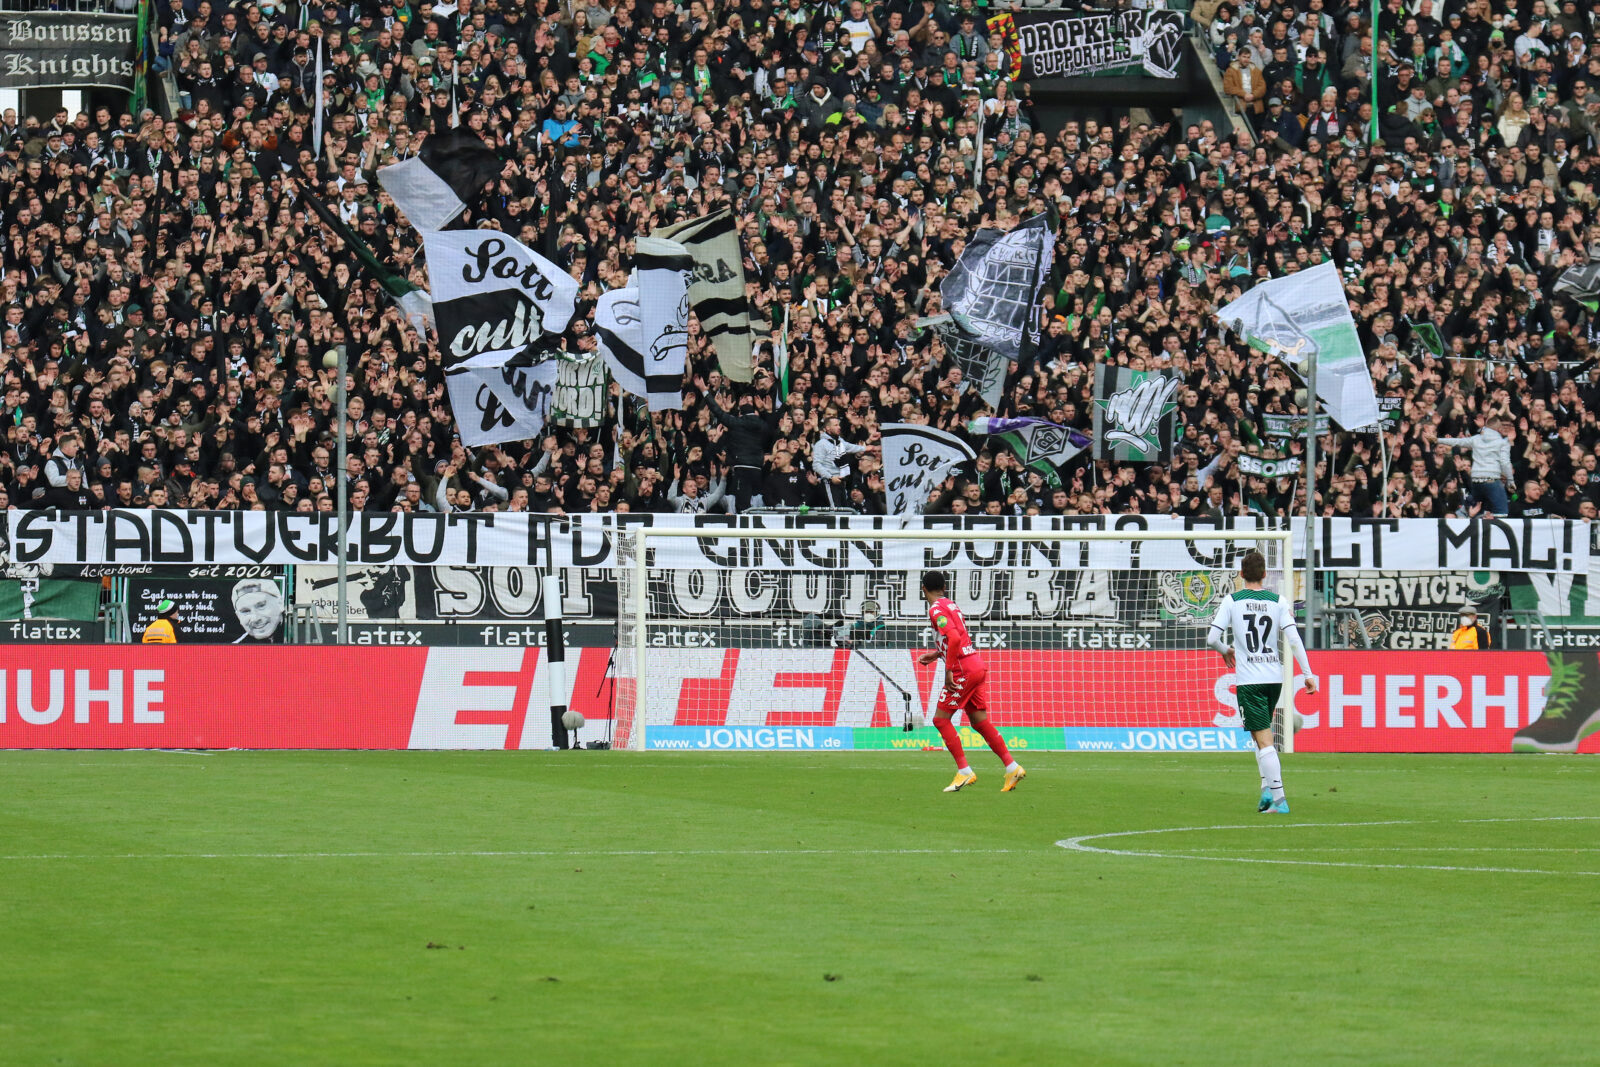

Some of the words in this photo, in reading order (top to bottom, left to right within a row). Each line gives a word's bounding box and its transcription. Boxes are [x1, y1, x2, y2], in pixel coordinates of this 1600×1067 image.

[7, 20, 132, 45] Borussen
[1021, 11, 1142, 55] DROPKIK
[4, 53, 135, 77] Knights
[16, 508, 494, 565] STADTVERBOT
[695, 514, 883, 568] EINEN
[1438, 518, 1573, 571] MAL!
[80, 564, 153, 577] Ackerbande
[189, 564, 220, 579] seit
[225, 565, 271, 578] 2006
[141, 588, 165, 602] Egal
[185, 590, 200, 600] wir
[1336, 576, 1466, 607] SERVICE
[179, 601, 194, 611] wir
[311, 598, 350, 607] rabaue
[187, 611, 220, 623] Herzen
[10, 624, 81, 639] flatex
[1063, 628, 1151, 648] flatex
[1243, 614, 1273, 653] 32
[407, 646, 971, 751] ELTEN
[698, 728, 814, 748] JONGEN
[1121, 730, 1237, 750] JONGEN
